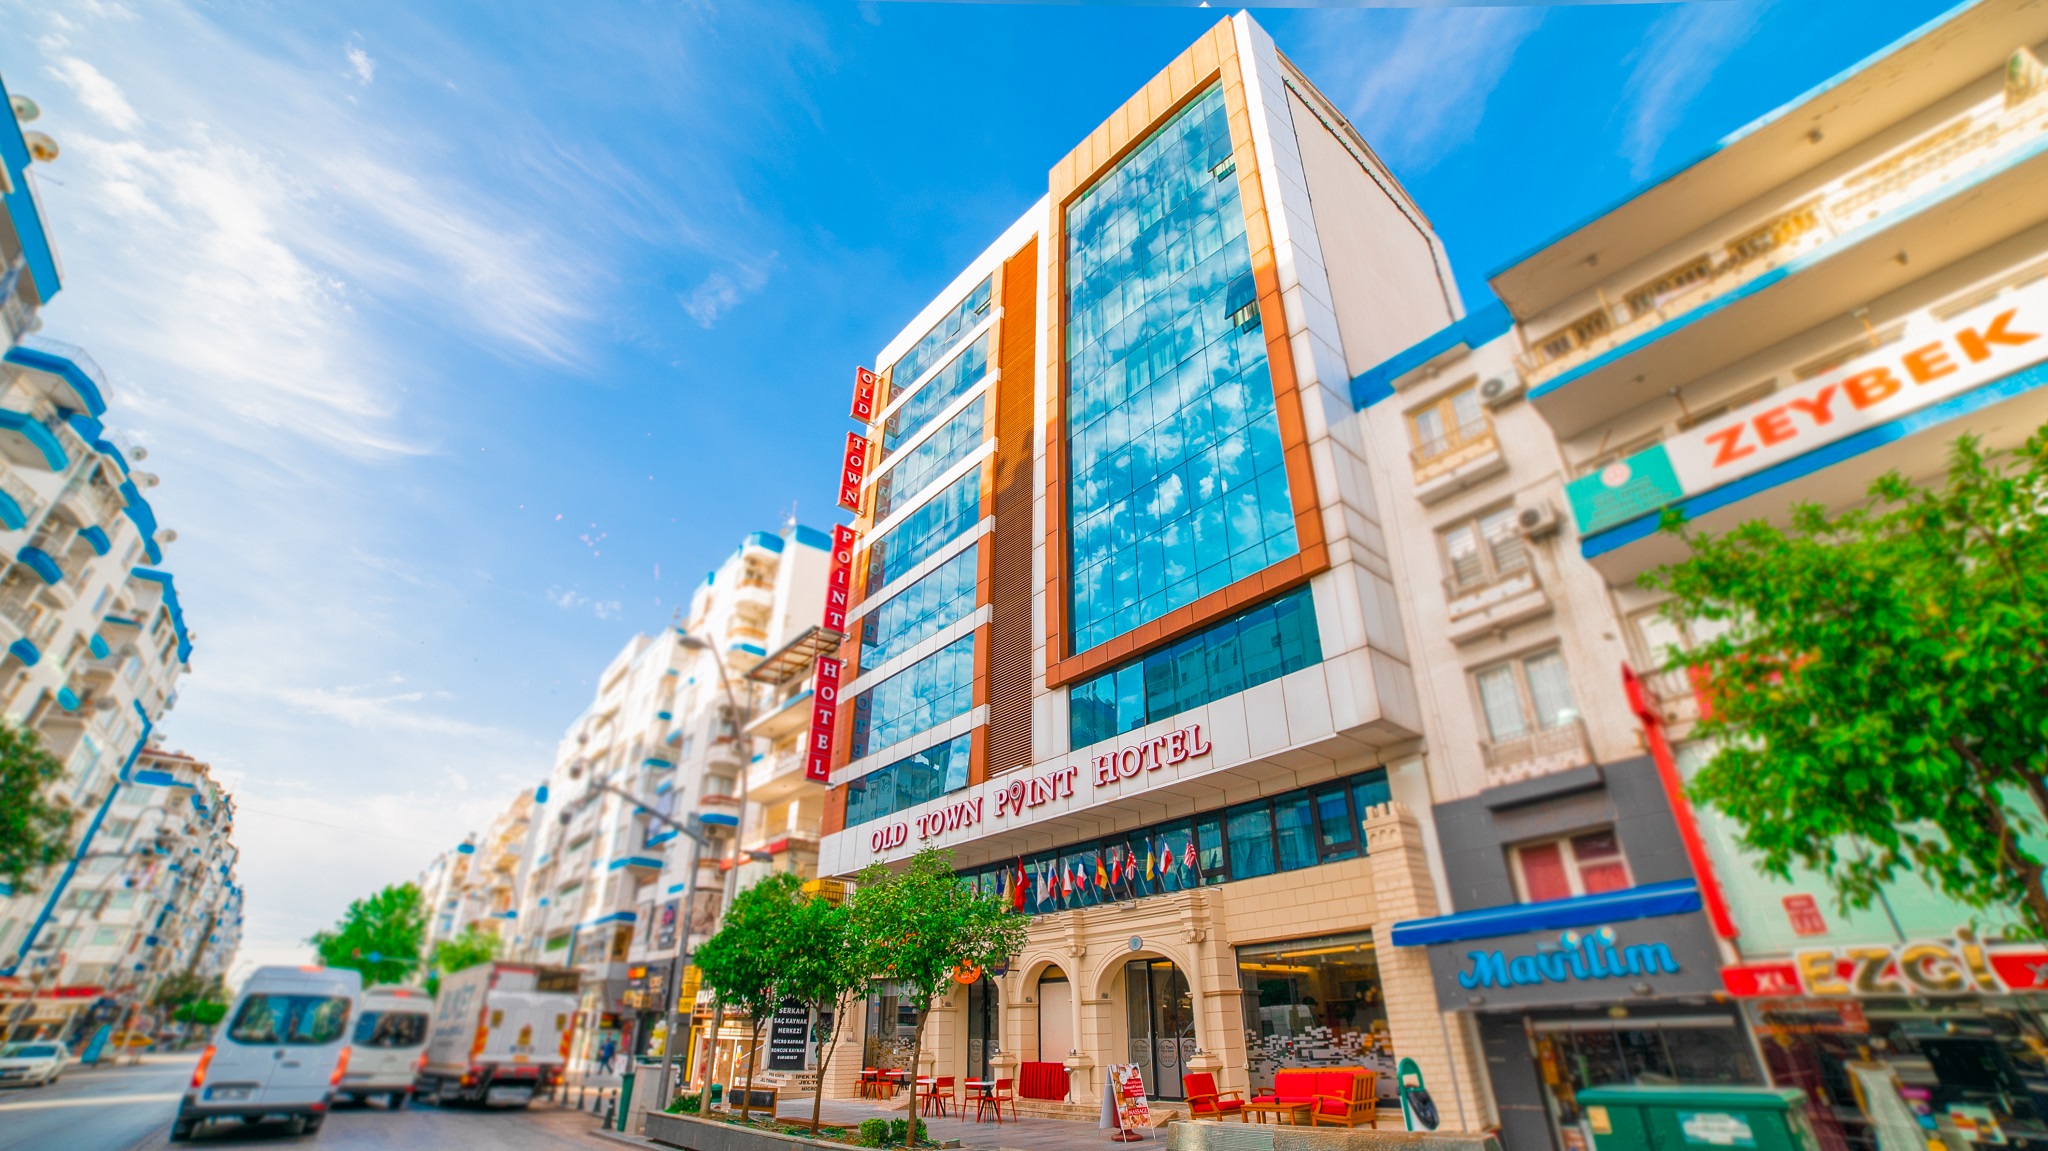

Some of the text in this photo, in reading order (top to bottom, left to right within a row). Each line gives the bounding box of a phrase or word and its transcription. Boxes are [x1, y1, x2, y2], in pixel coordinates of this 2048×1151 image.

[1704, 307, 2041, 468] ZEYBEK
[814, 373, 873, 775] OLD TOWN POINT HOTEL
[871, 724, 1212, 853] OLD TOWN POINT HOTEL
[1458, 925, 1680, 989] Mavilim
[1753, 971, 1796, 990] XL
